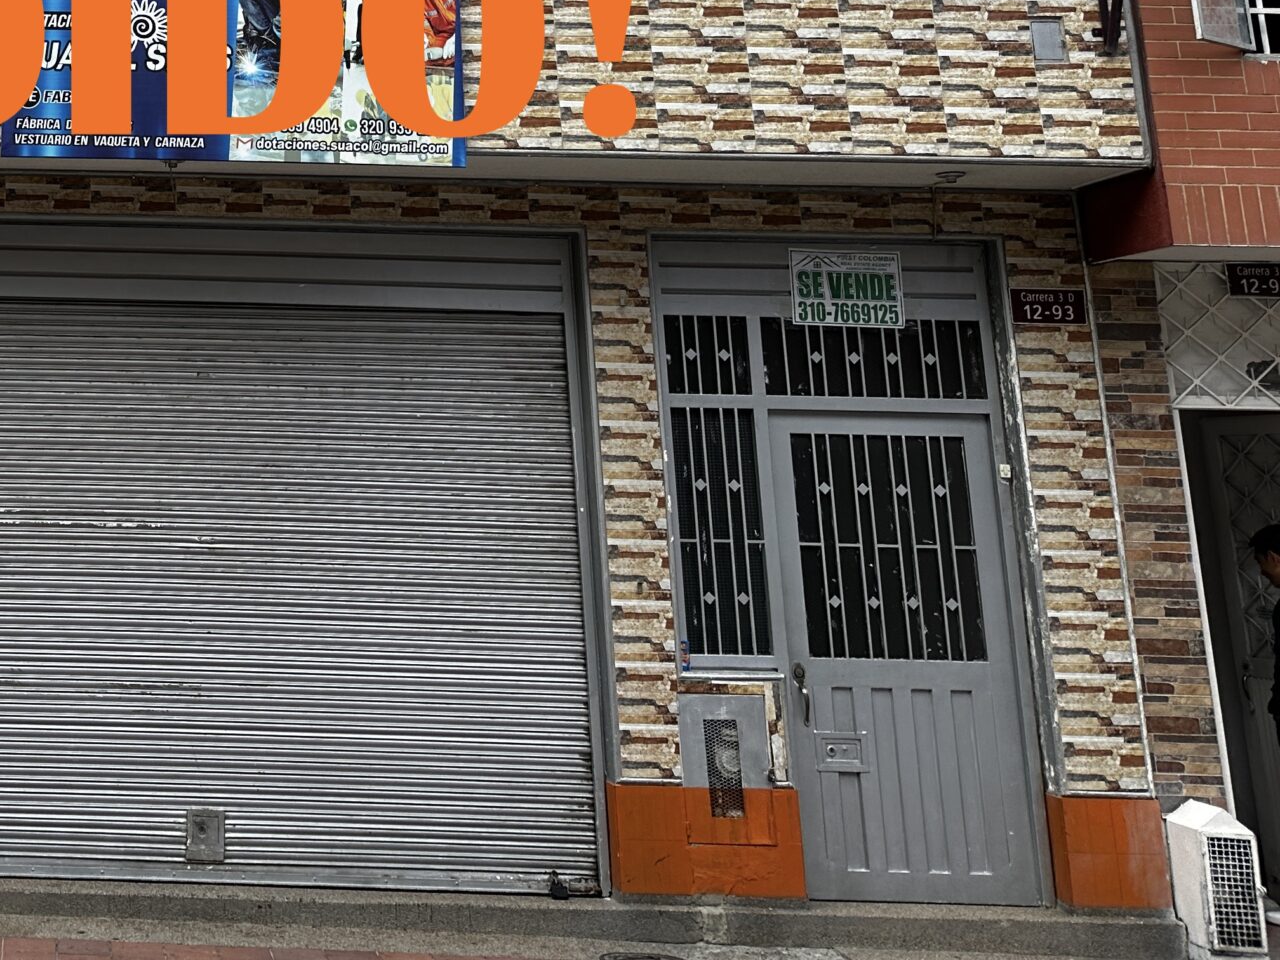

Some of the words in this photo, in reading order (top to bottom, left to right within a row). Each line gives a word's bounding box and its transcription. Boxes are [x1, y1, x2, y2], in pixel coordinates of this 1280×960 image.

[16, 117, 61, 130] FÁBRICA
[308, 118, 339, 133] 4904
[361, 120, 384, 134] 320
[14, 133, 72, 146] VESTUARIO
[74, 135, 88, 146] EN
[93, 135, 140, 147] VAQUETA
[143, 136, 151, 147] Y
[155, 137, 205, 149] CARNAZA
[256, 137, 449, 154] dotaciones.suacol@gmail.com
[1236, 266, 1270, 277] Carrera
[797, 270, 825, 300] SE
[827, 271, 897, 301] VENDE
[1240, 278, 1280, 294] 12-9
[1020, 292, 1054, 302] Carrera
[1058, 293, 1064, 302] 3
[1068, 293, 1075, 303] D
[798, 301, 900, 325] 310-7669125
[1023, 304, 1075, 321] 12-93
